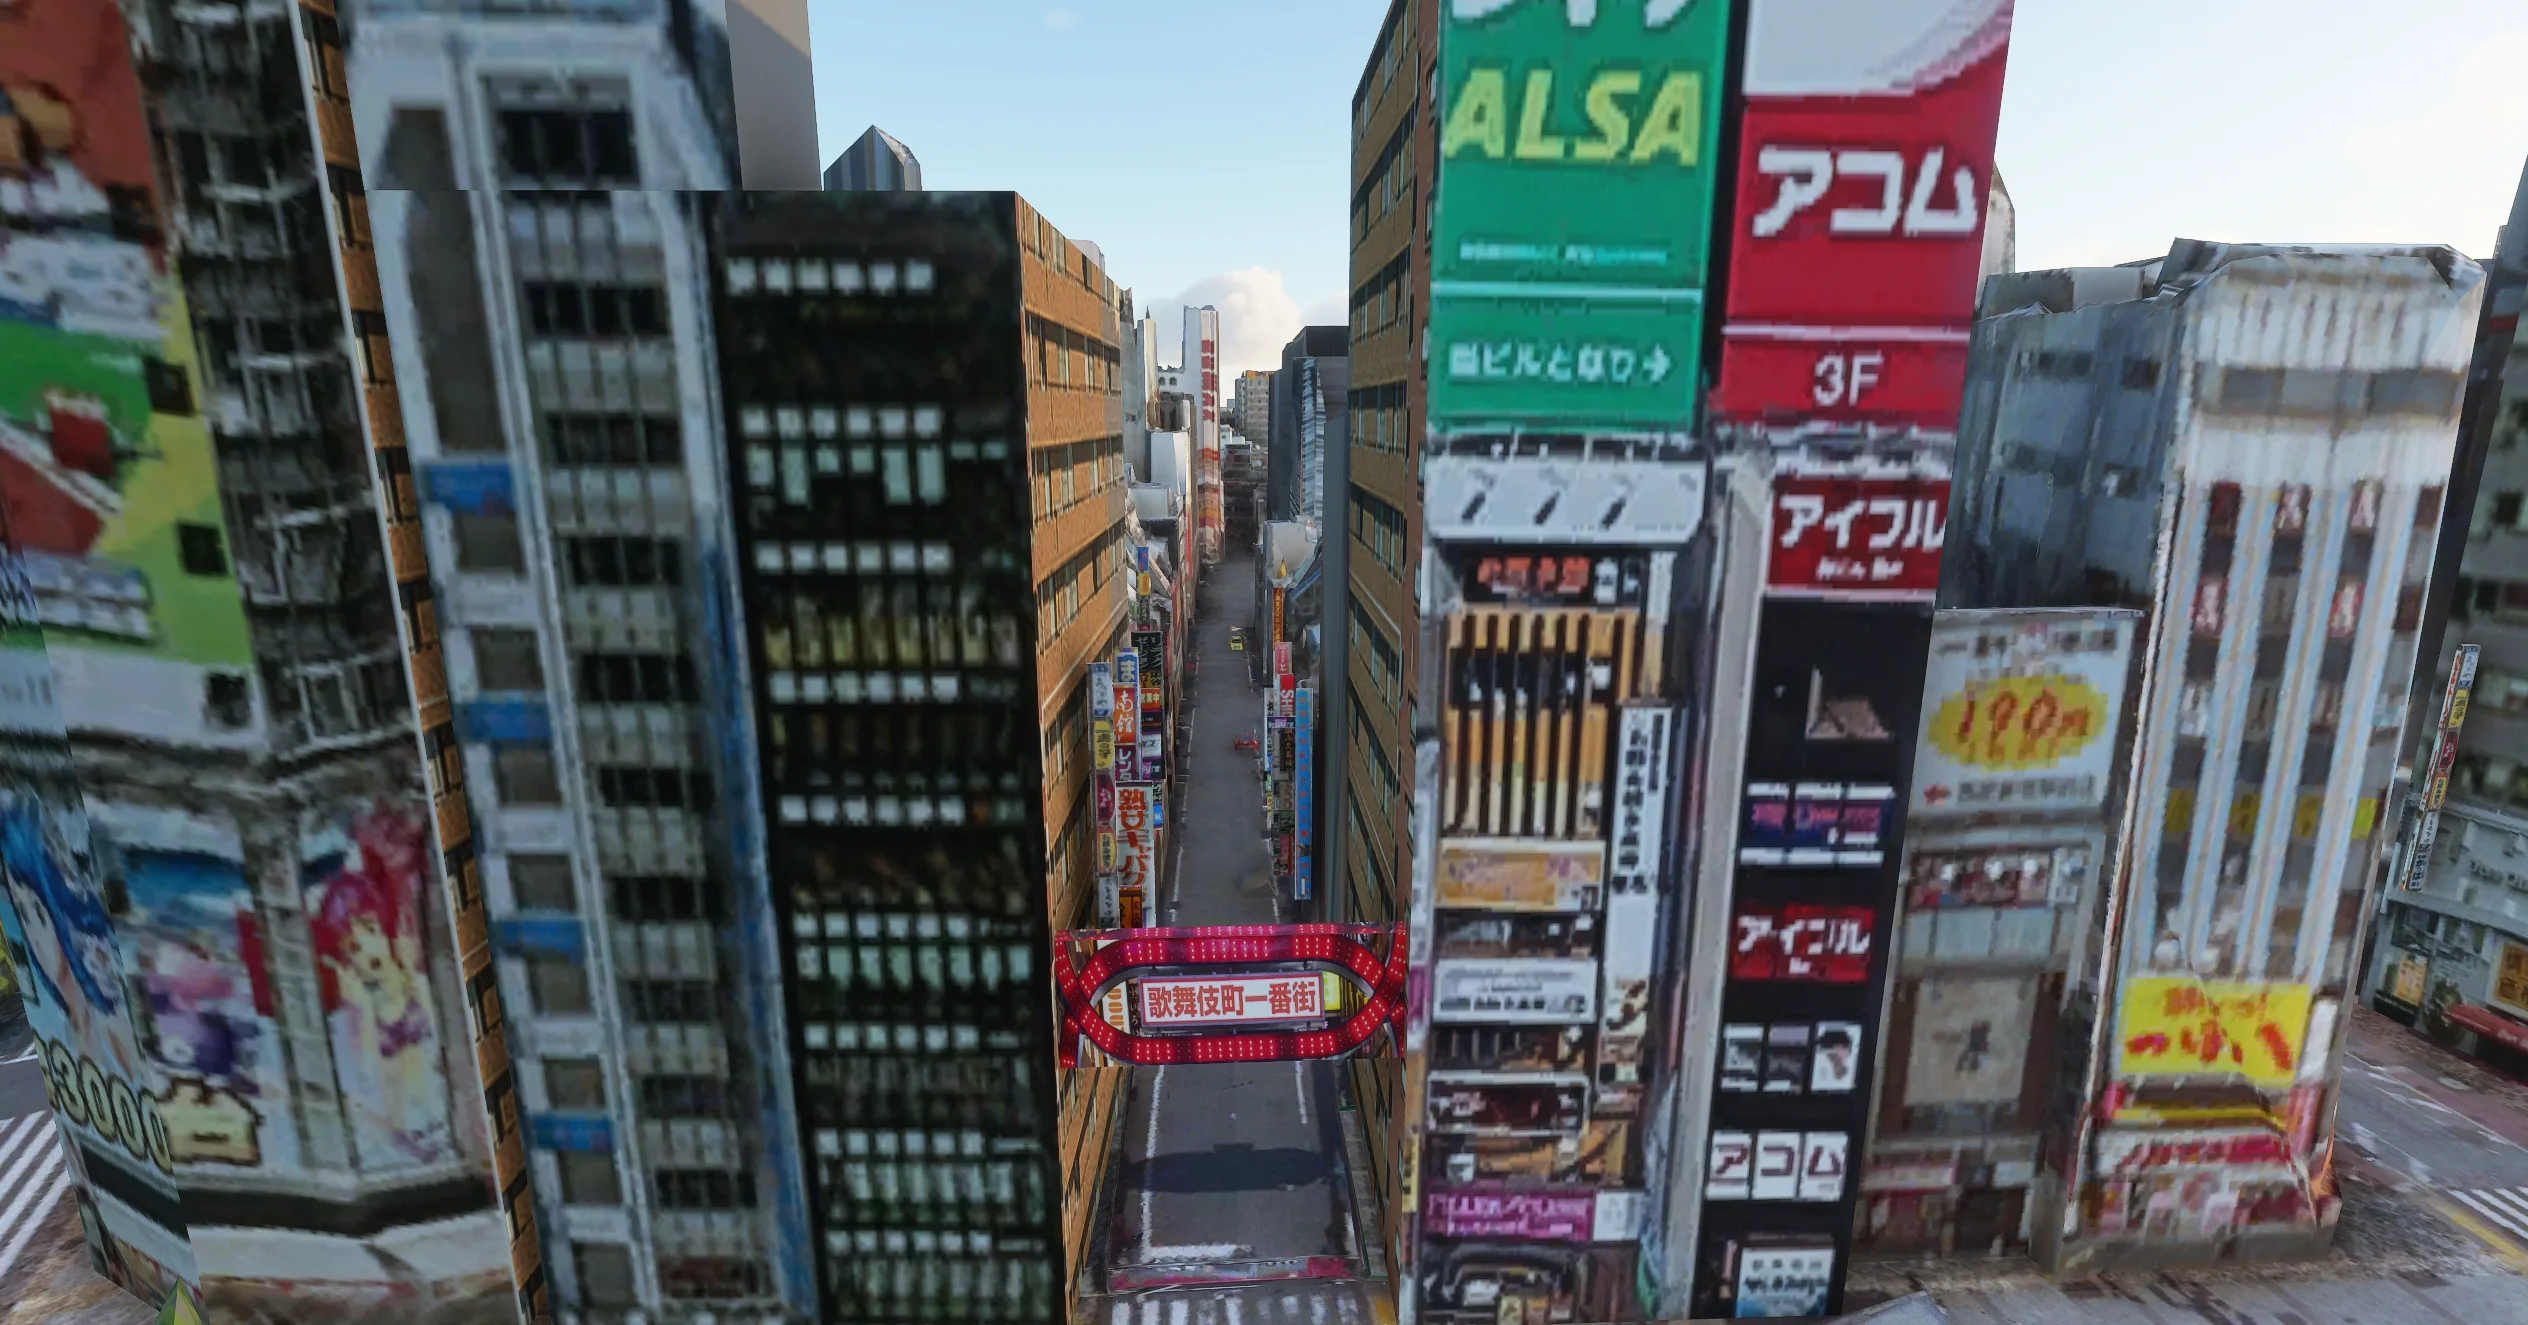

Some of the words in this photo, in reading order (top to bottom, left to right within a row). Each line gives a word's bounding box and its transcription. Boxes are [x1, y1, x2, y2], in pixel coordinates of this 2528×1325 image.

[1445, 68, 1700, 166] ALSA
[1753, 146, 1979, 238] アコム
[1813, 350, 1884, 406] 3F
[1779, 494, 1947, 551] アイフル
[1147, 981, 1317, 1018] 歌舞伎町一番街
[1713, 1144, 1843, 1177] アコム
